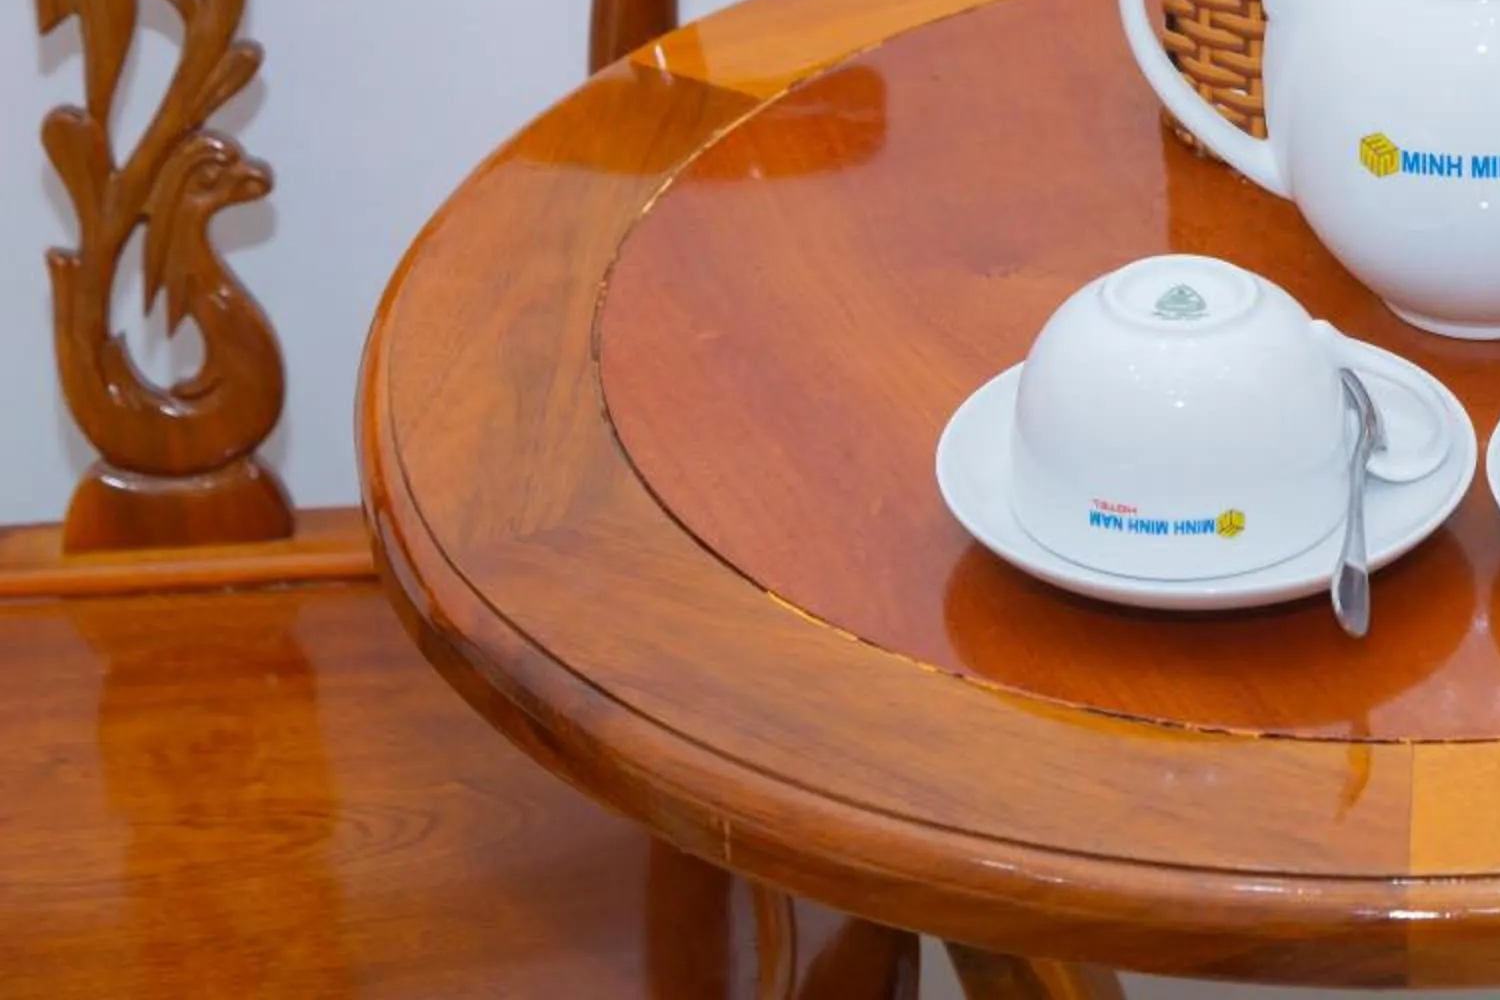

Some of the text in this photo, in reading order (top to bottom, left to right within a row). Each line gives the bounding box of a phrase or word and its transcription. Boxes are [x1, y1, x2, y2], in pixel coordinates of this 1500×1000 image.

[1401, 150, 1463, 178] MINH
[1092, 499, 1138, 515] HOTEL
[1089, 510, 1215, 536] MINH MINH NAM
